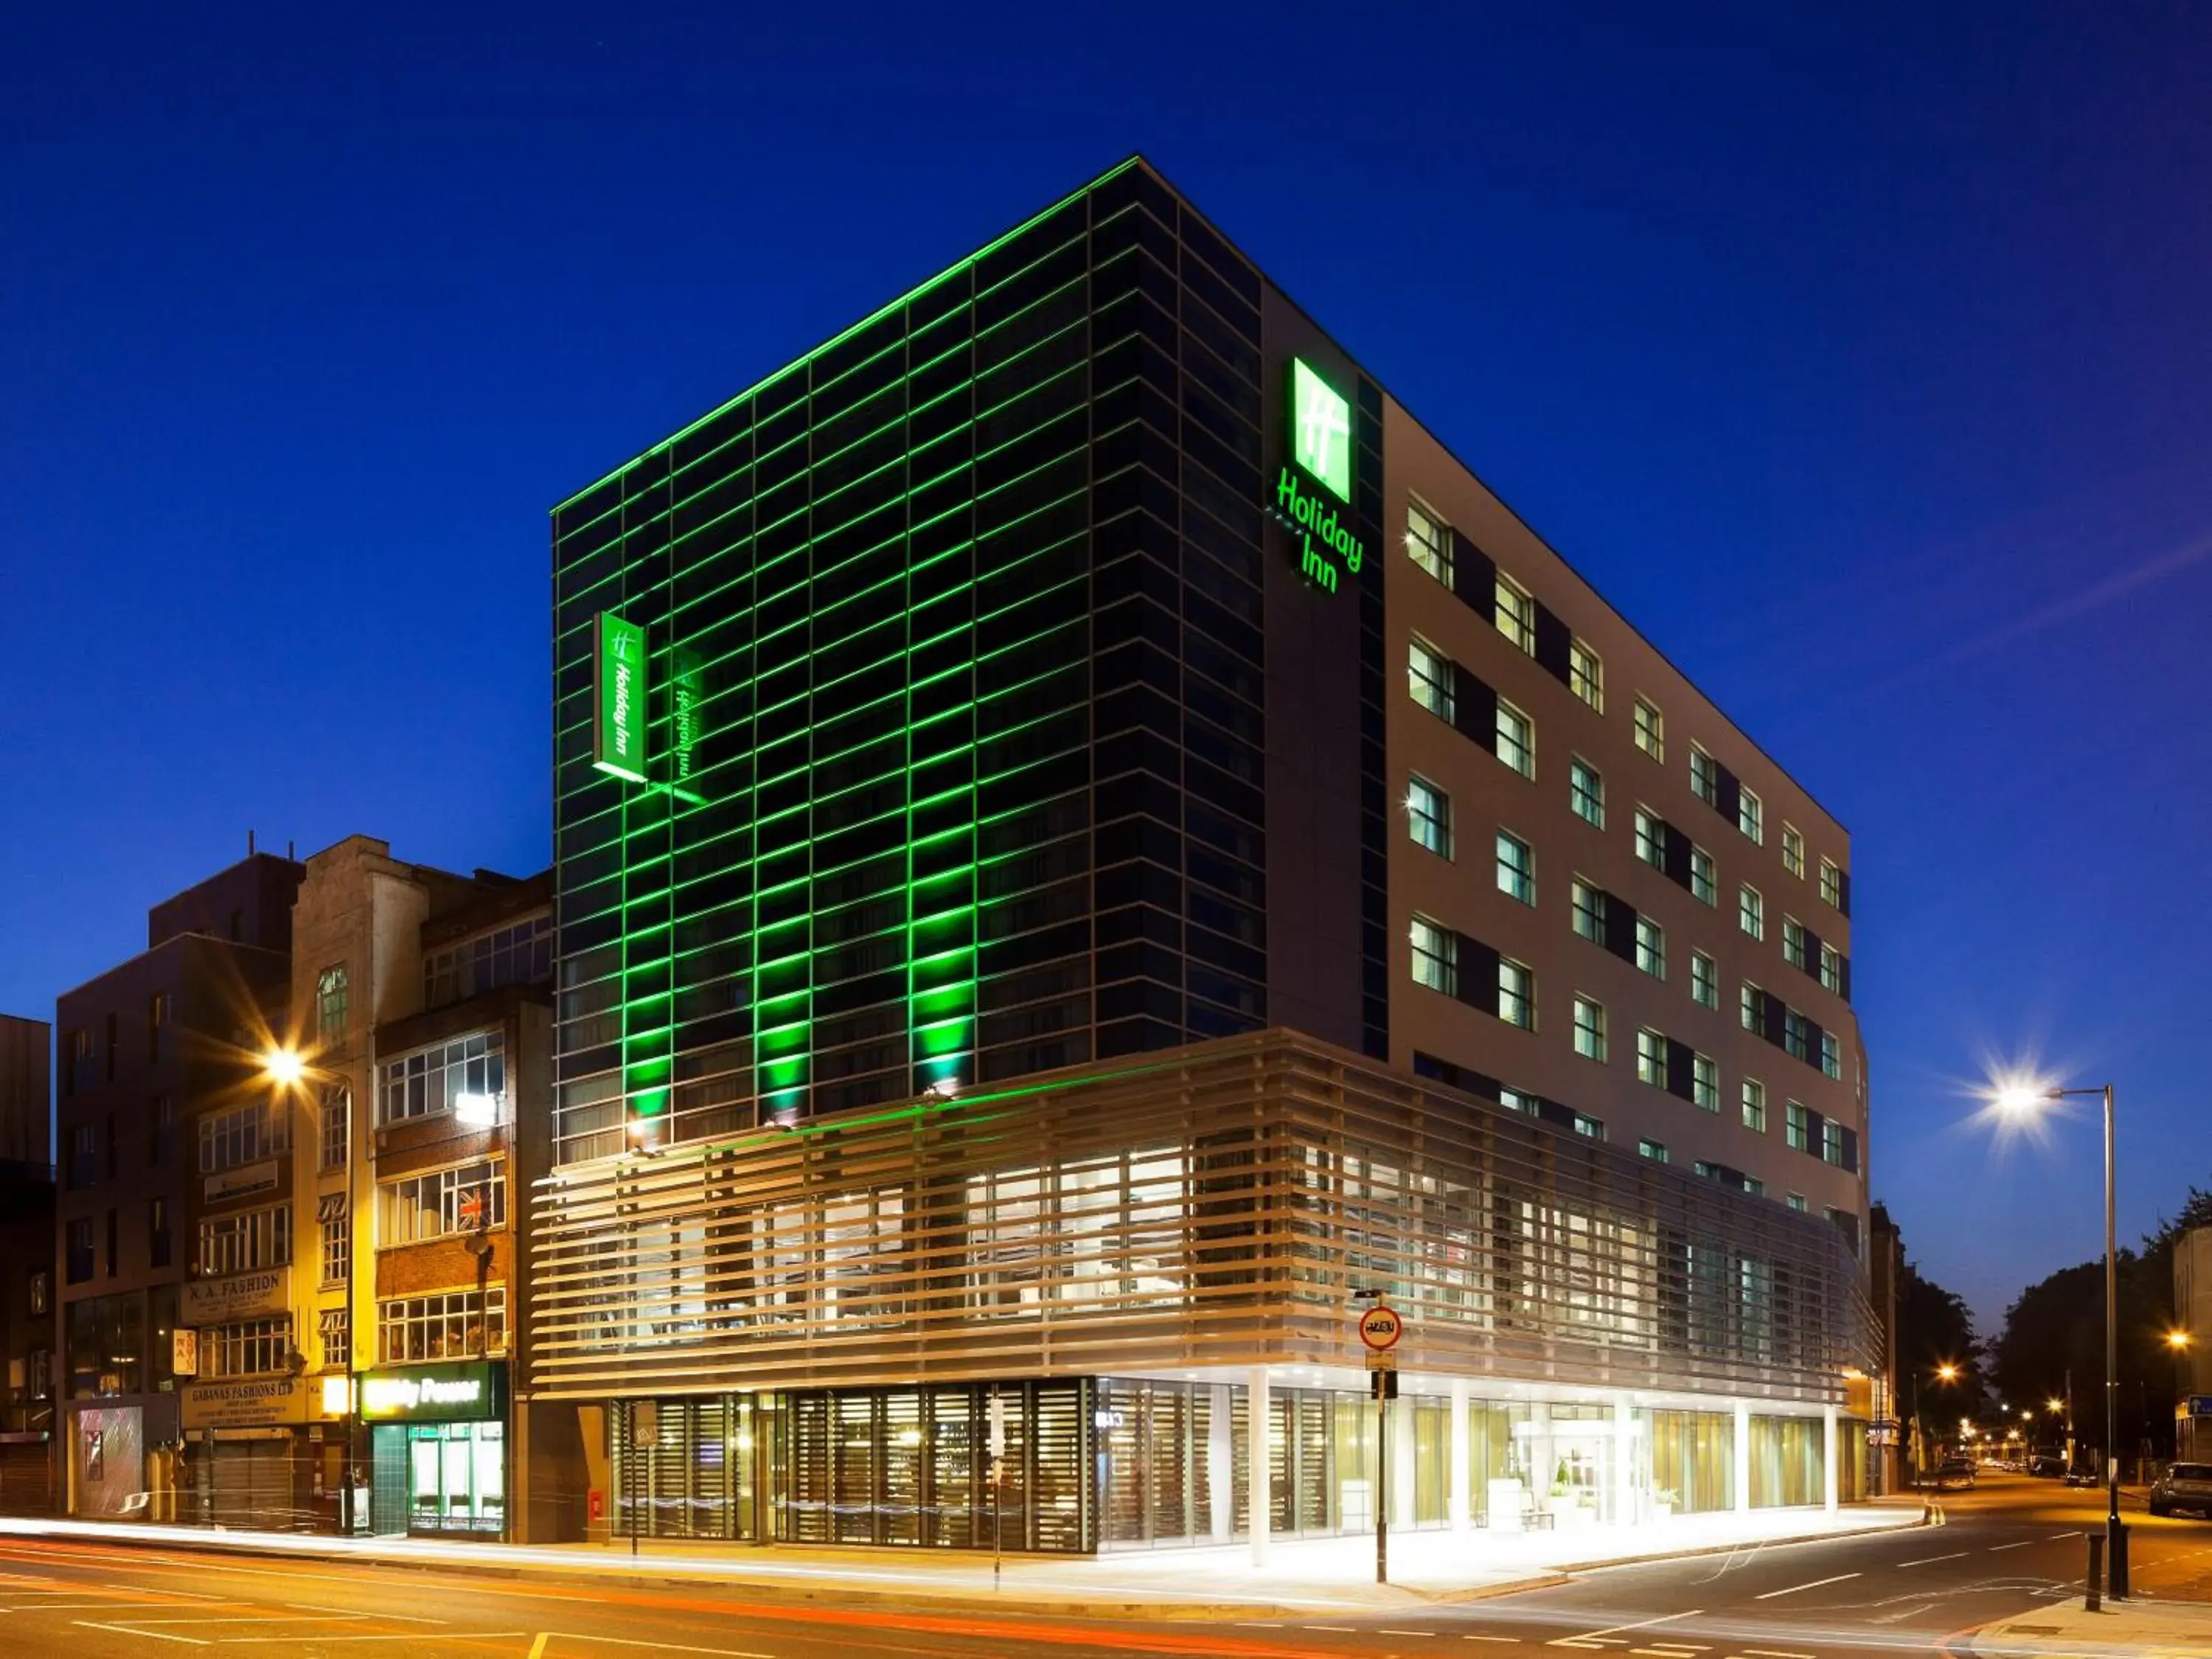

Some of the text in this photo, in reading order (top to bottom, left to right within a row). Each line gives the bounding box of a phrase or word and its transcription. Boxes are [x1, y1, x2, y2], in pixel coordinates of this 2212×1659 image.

[1278, 467, 1363, 573] Holiday
[1302, 533, 1338, 594] Inn
[613, 662, 631, 757] Holiday Inn
[223, 1274, 279, 1295] FASHION
